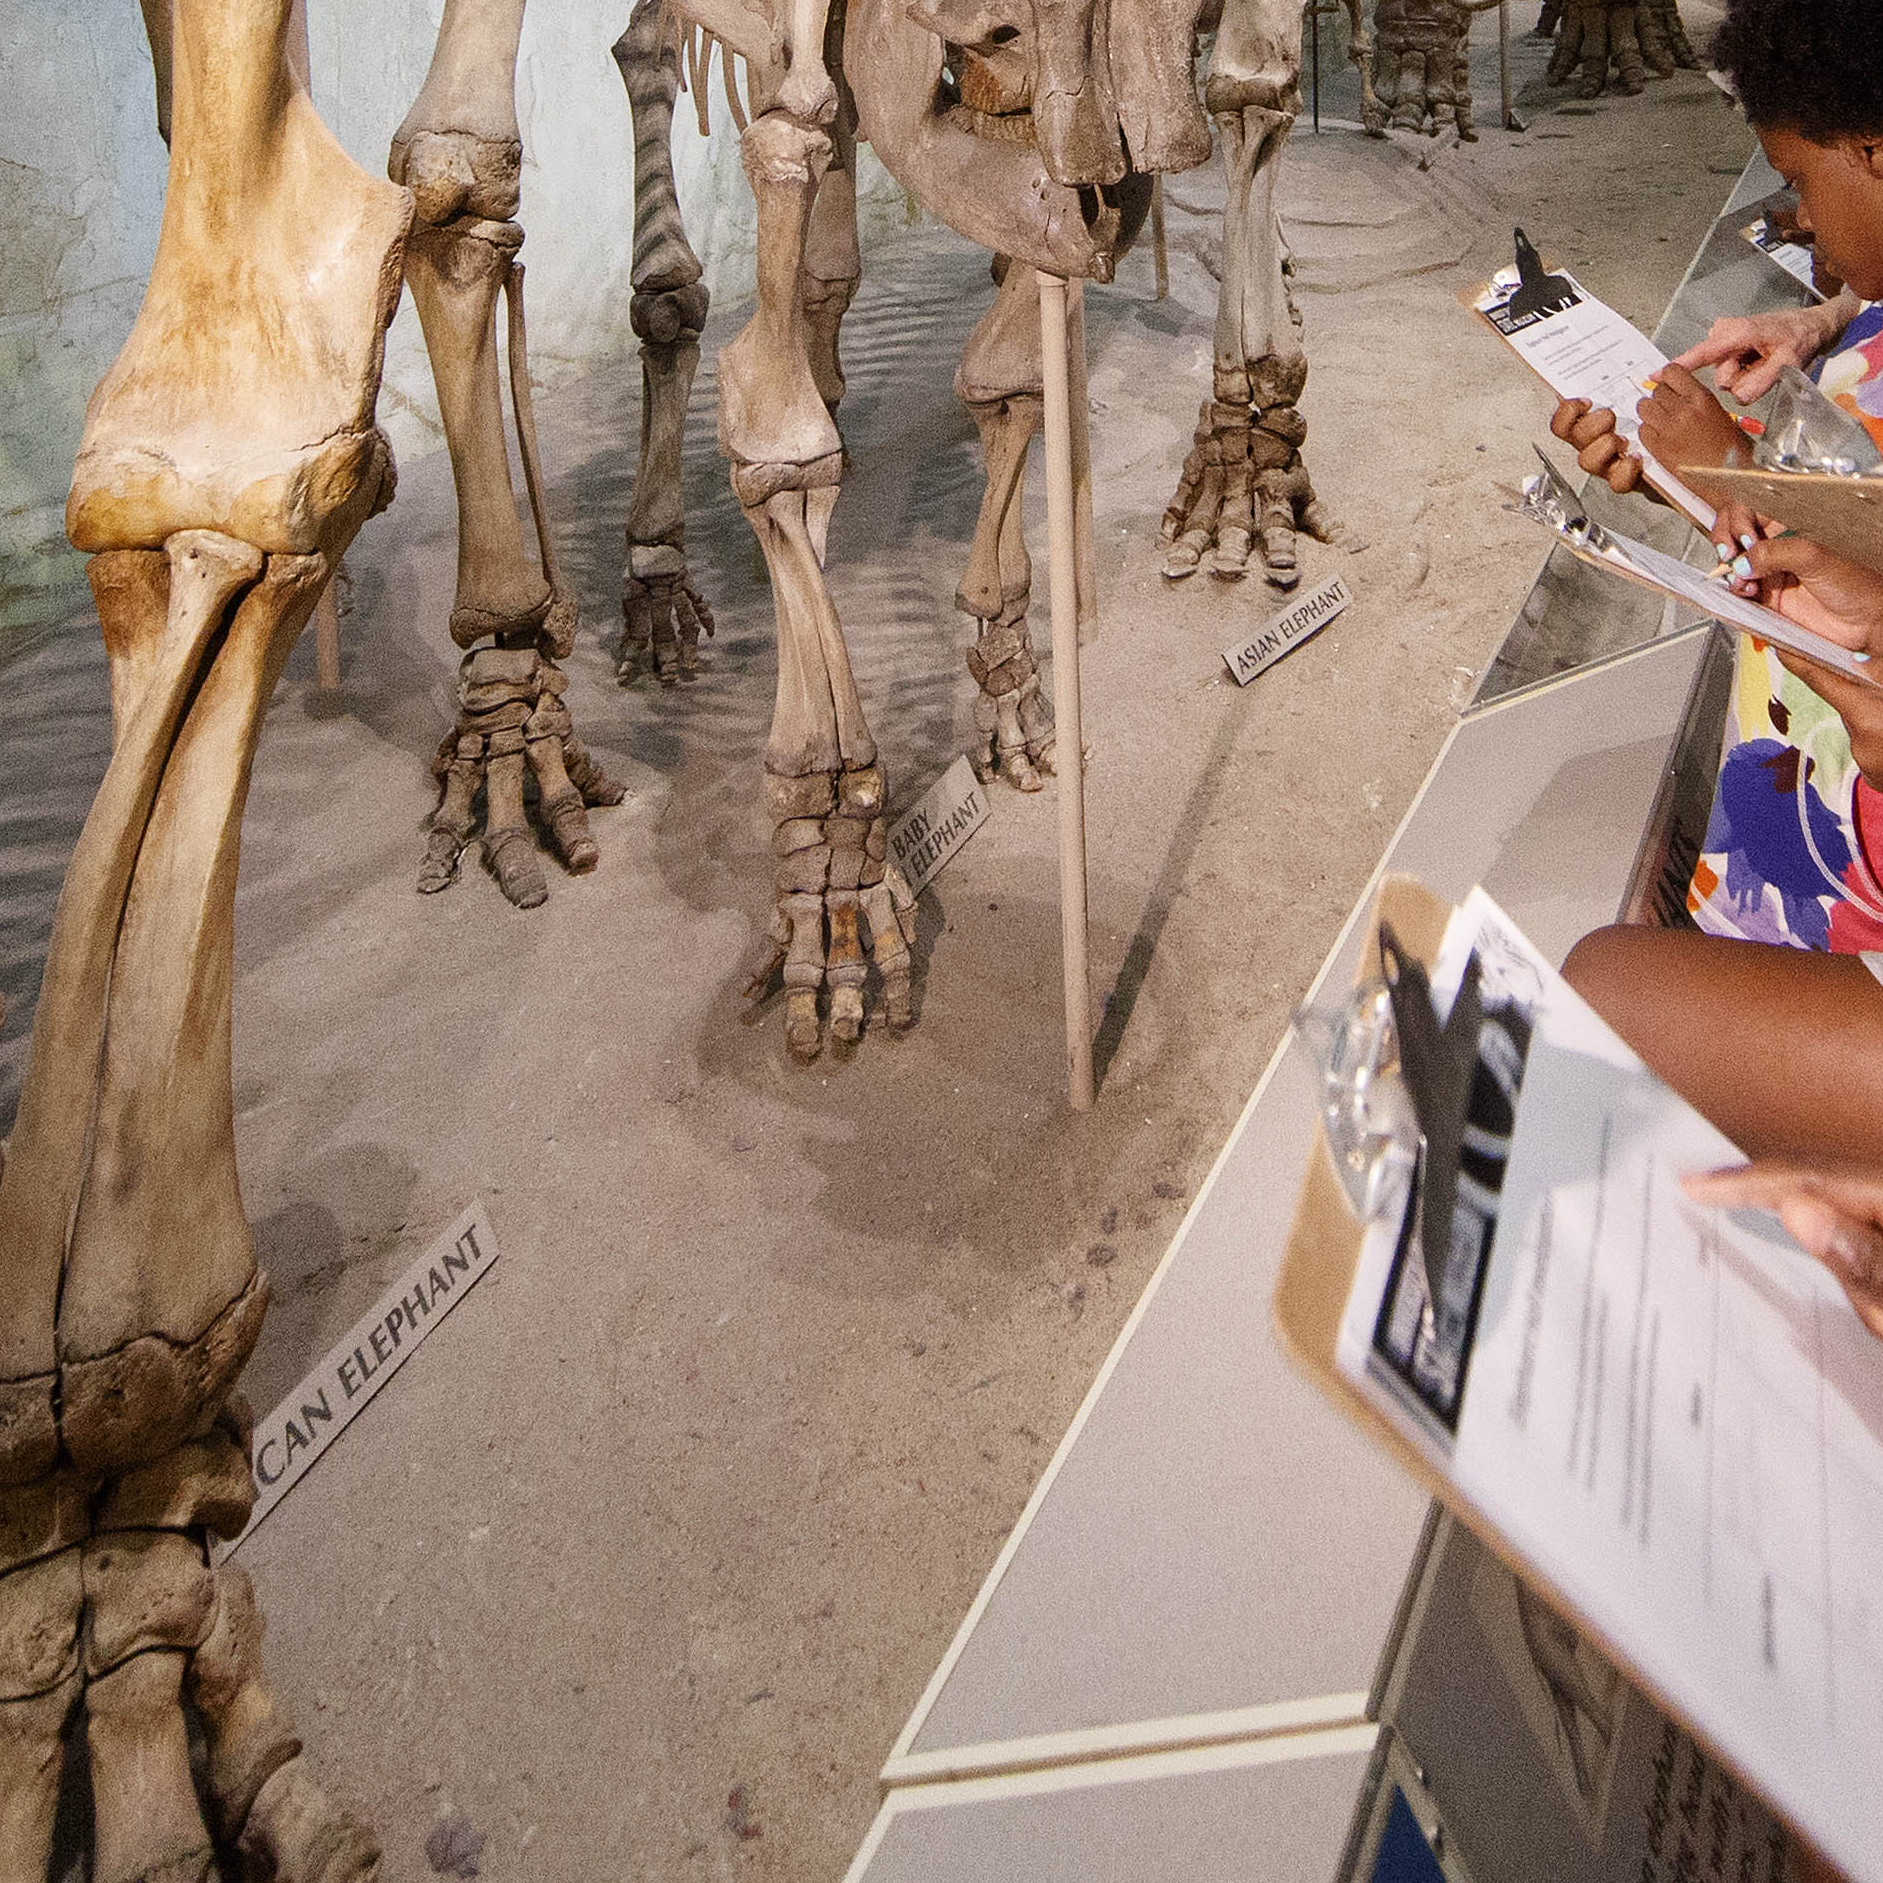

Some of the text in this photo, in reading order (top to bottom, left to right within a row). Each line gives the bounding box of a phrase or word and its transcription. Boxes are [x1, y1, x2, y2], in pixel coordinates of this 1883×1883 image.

[1237, 581, 1347, 675] ASIAN ELEPHANT
[892, 810, 934, 861] BABY
[909, 792, 981, 877] ELEPHANT
[336, 1223, 485, 1398] ELEPHANT
